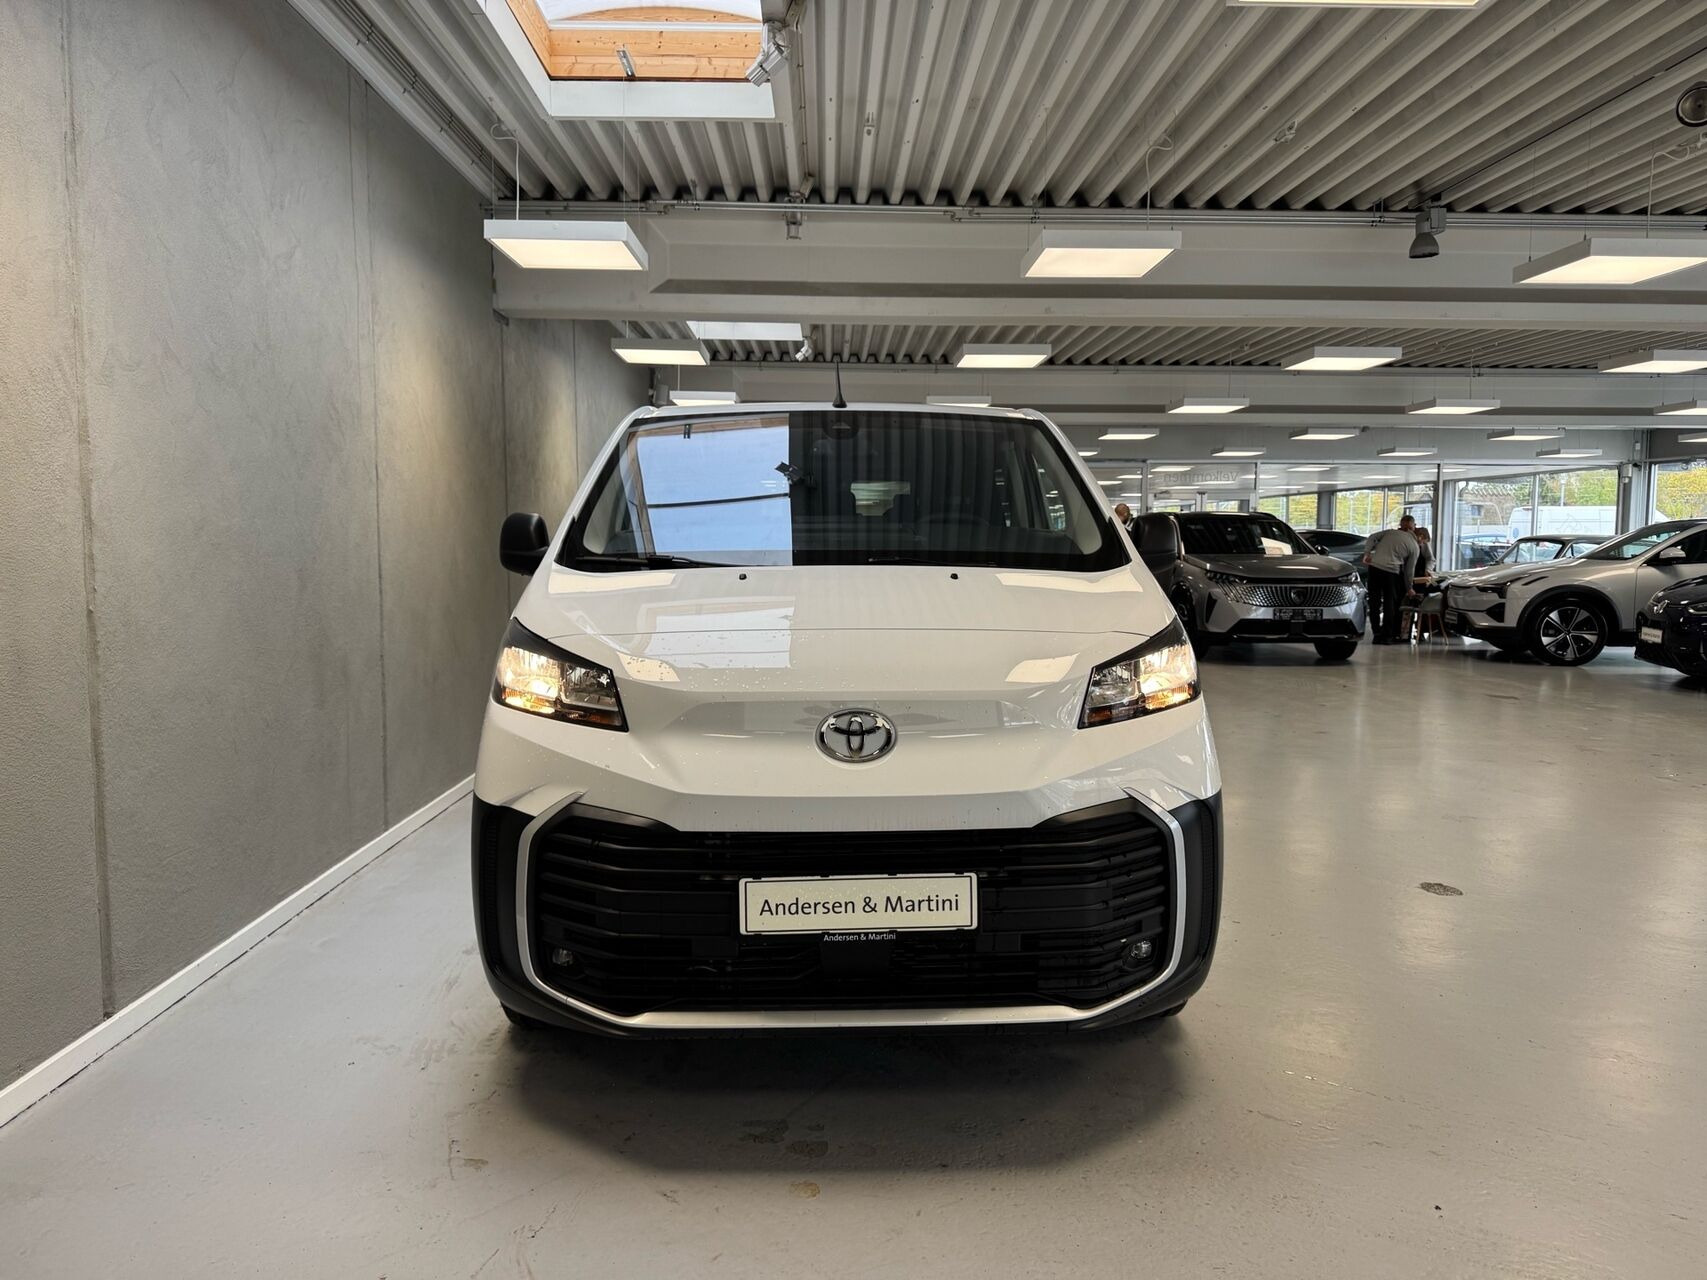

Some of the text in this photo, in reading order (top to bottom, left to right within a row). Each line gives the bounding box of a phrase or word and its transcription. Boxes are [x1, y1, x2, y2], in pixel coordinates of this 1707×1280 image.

[760, 893, 959, 916] Andersen & Martini
[823, 932, 896, 942] Andersen & Martini
